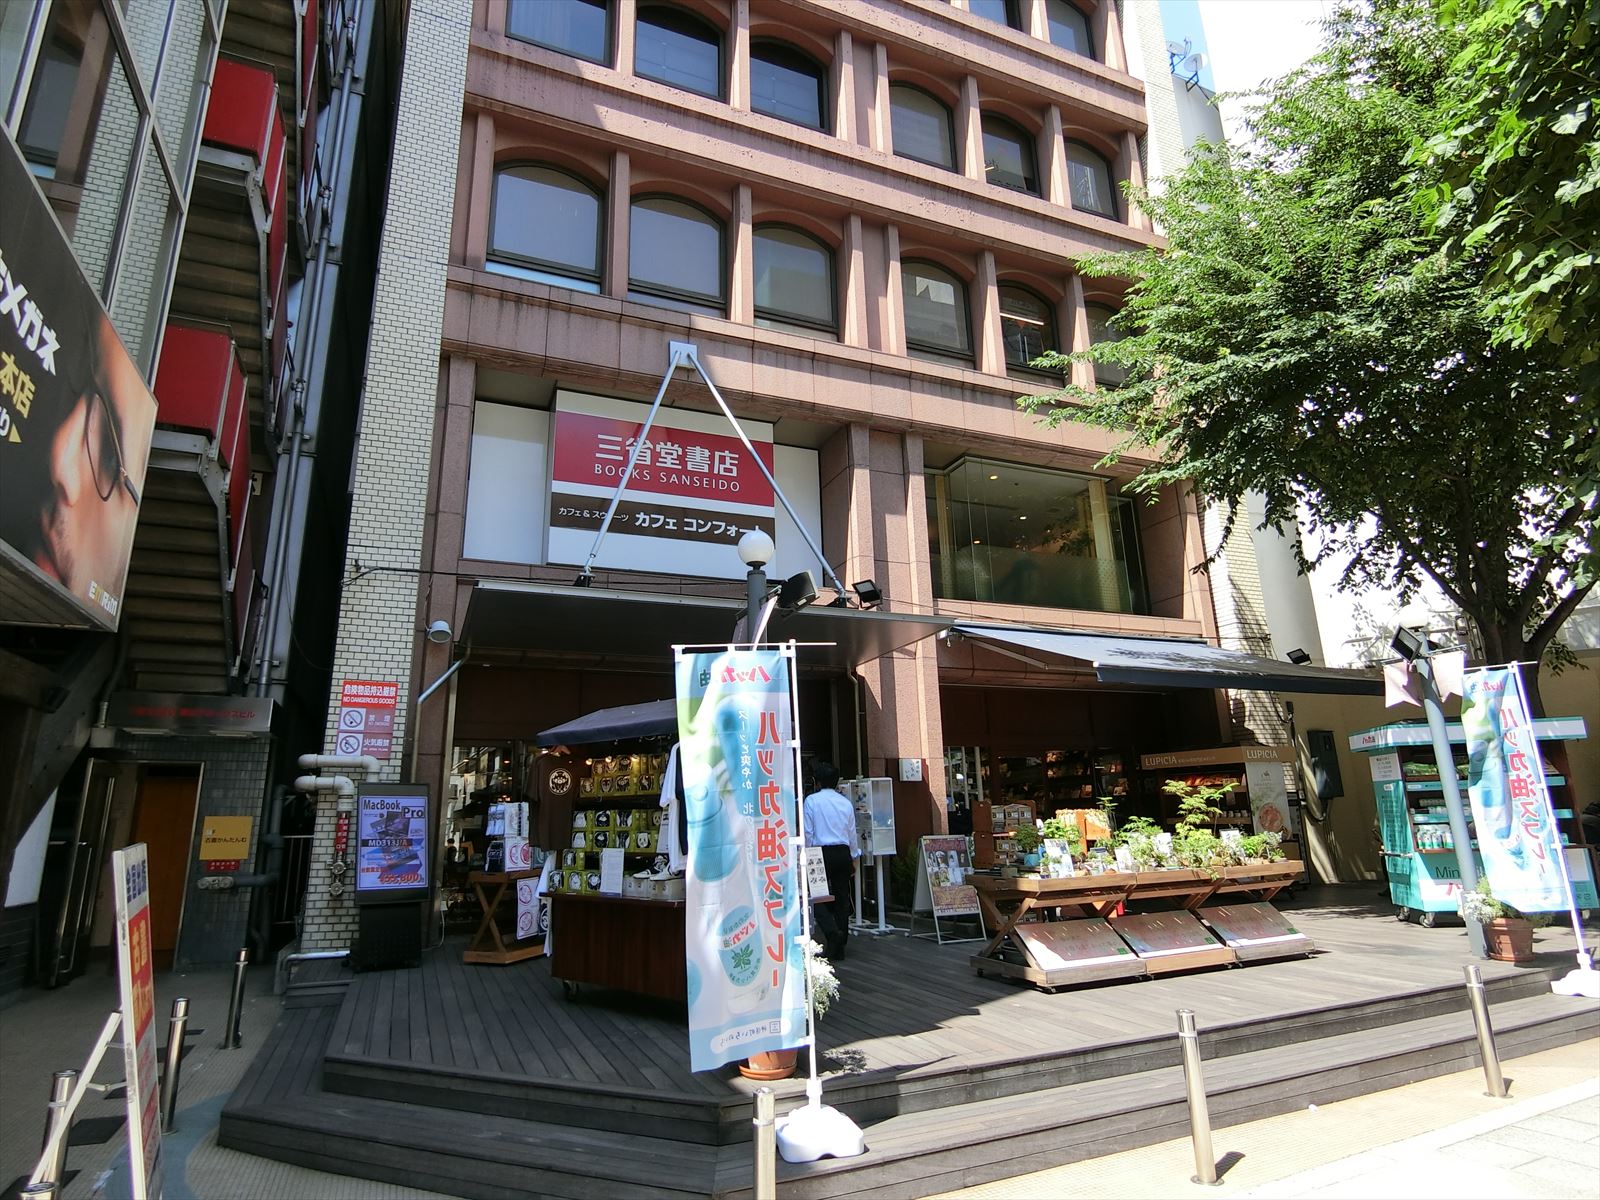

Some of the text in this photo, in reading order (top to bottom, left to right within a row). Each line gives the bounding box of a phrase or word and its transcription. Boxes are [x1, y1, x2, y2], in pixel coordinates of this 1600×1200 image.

[0, 352, 36, 419] 本店
[595, 433, 739, 477] 三省堂書店
[594, 463, 740, 492] BOOKS SANSEIDO
[635, 511, 677, 530] カフェ
[683, 517, 760, 537] コンフォー
[1145, 756, 1178, 766] LUPICIA
[1246, 749, 1279, 759] LUPICIA
[363, 799, 401, 810] MacBook
[403, 807, 424, 818] Pro
